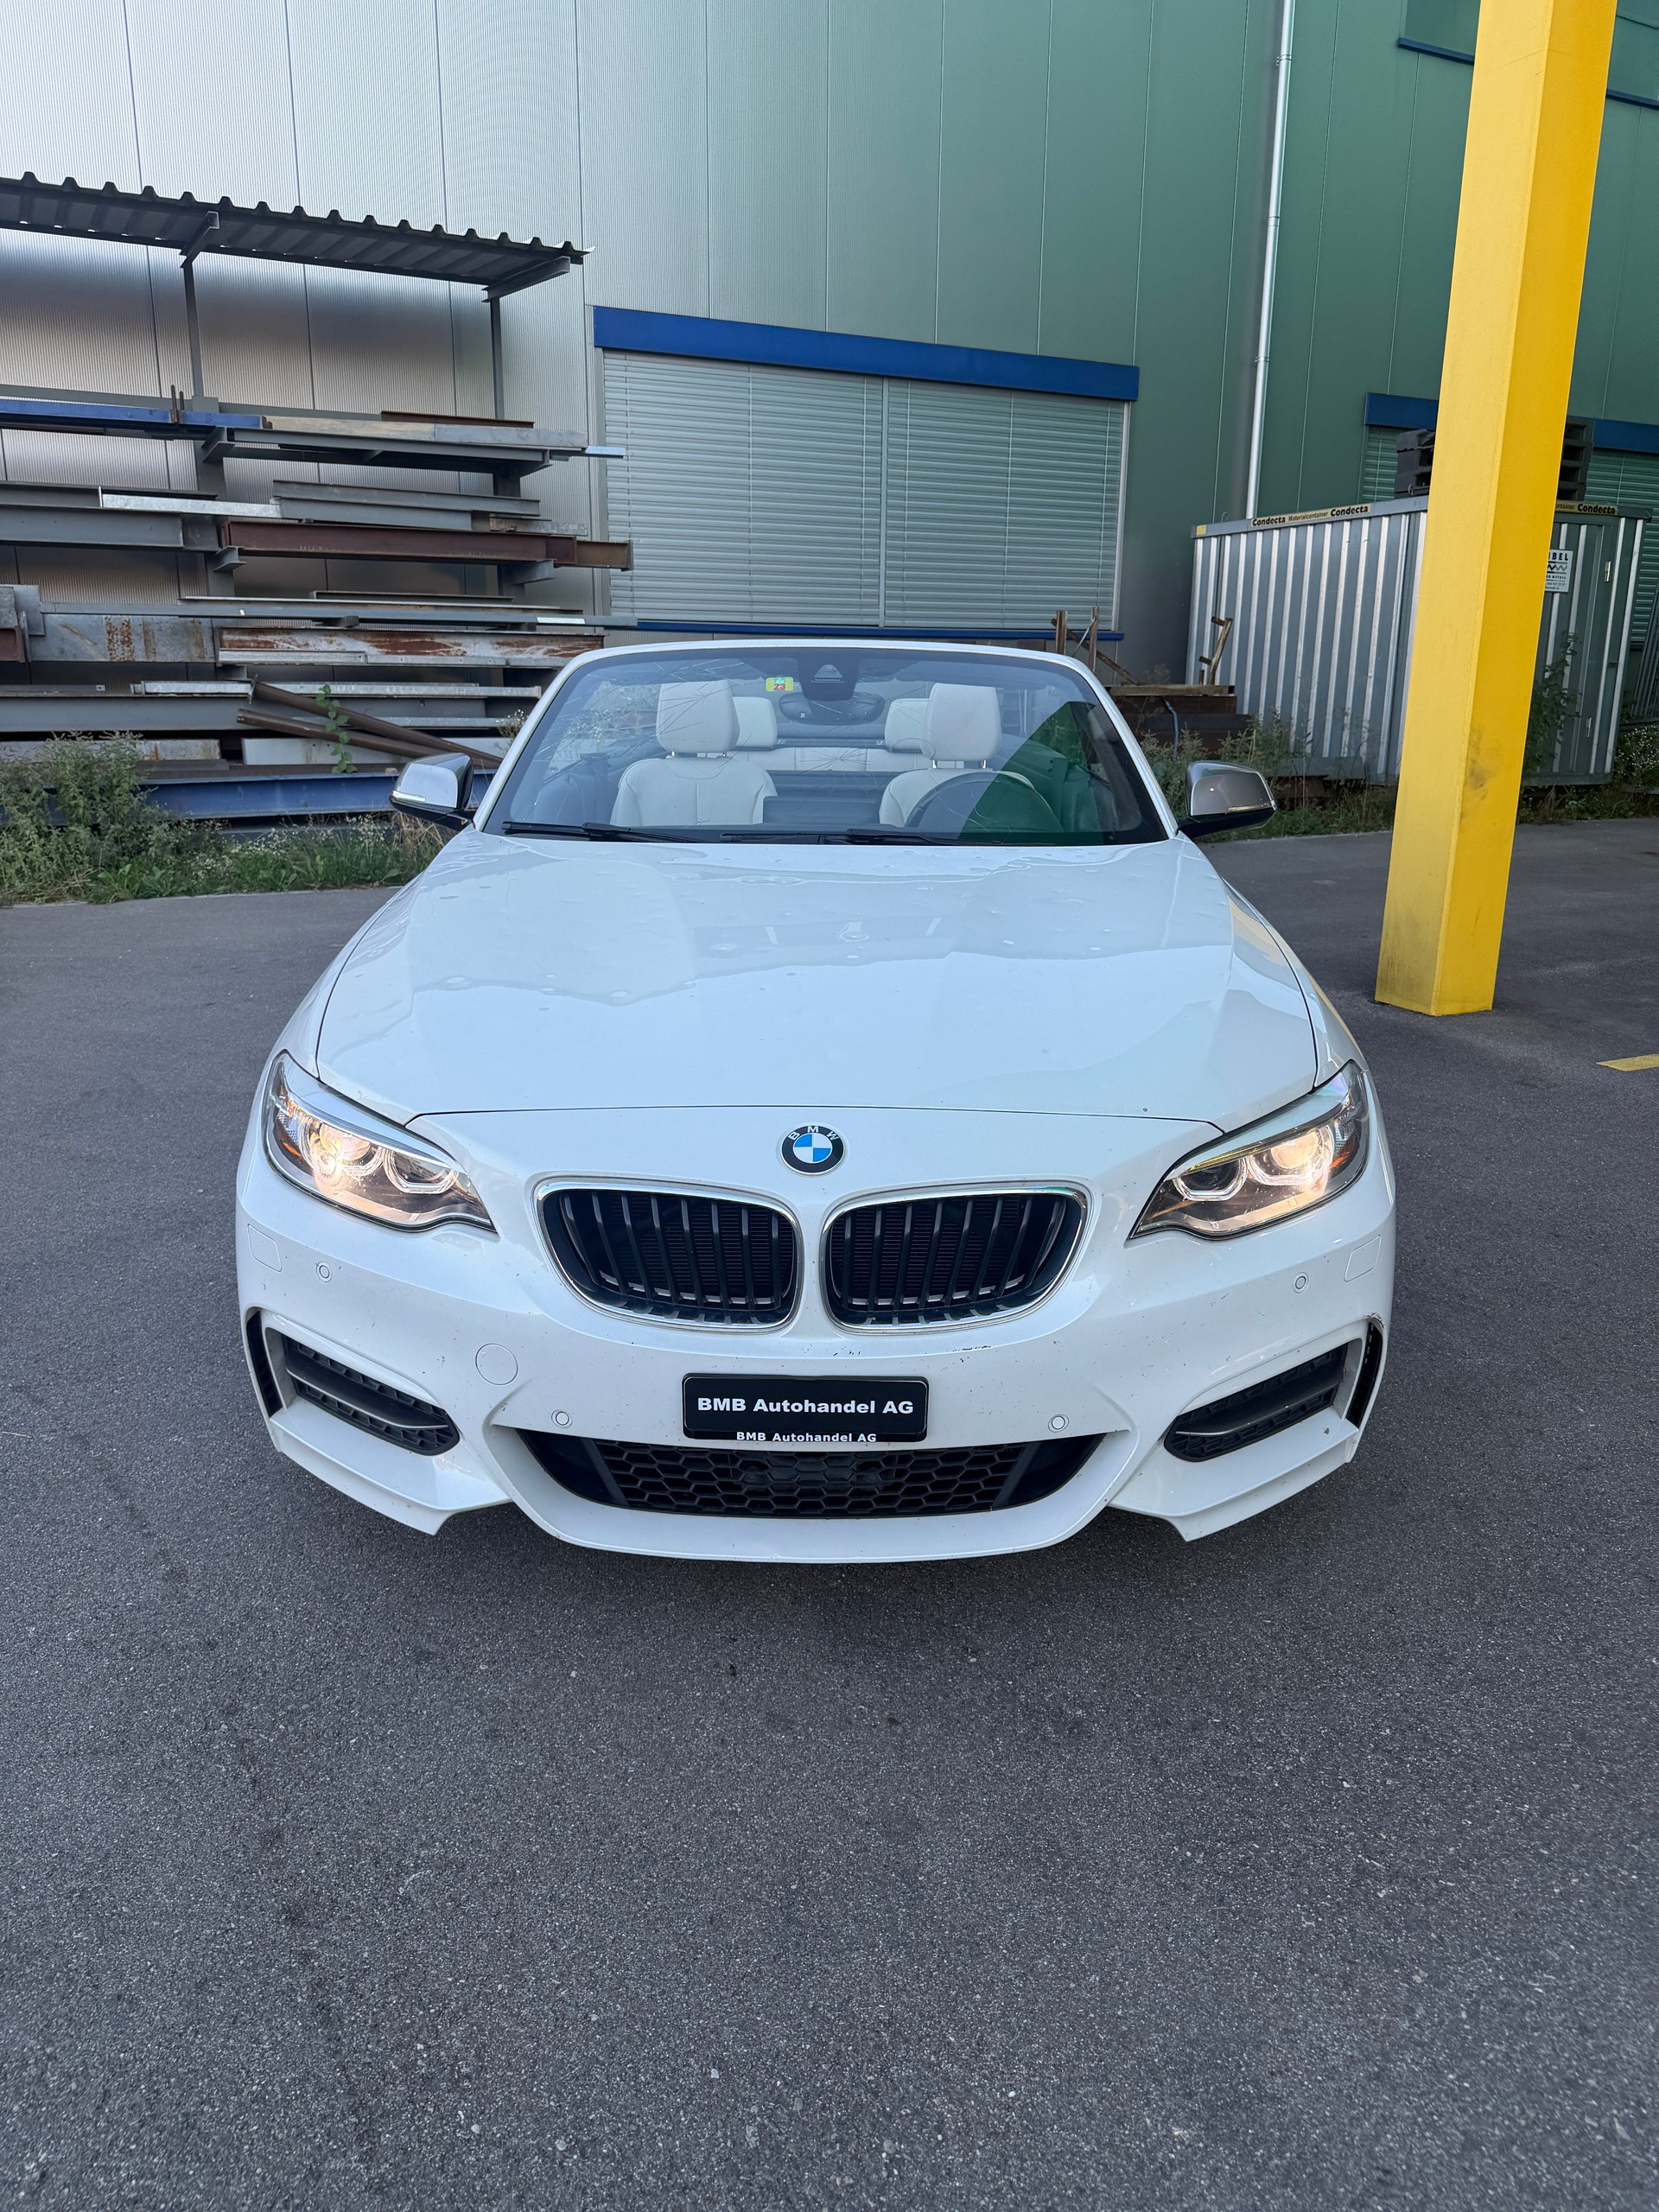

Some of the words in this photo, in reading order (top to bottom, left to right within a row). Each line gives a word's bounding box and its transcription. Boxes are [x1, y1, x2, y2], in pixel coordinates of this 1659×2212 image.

[1252, 516, 1286, 526] Condecta
[1288, 512, 1329, 521] Materialcontainer
[1331, 505, 1368, 517] Condecta
[1578, 504, 1616, 514] Condecta
[788, 1126, 839, 1141] BMW
[697, 1397, 747, 1411] BMB
[753, 1398, 875, 1414] Autohandel
[882, 1401, 913, 1414] AG
[736, 1432, 766, 1440] BMB
[772, 1433, 852, 1442] Autohandel
[857, 1433, 877, 1442] AG
